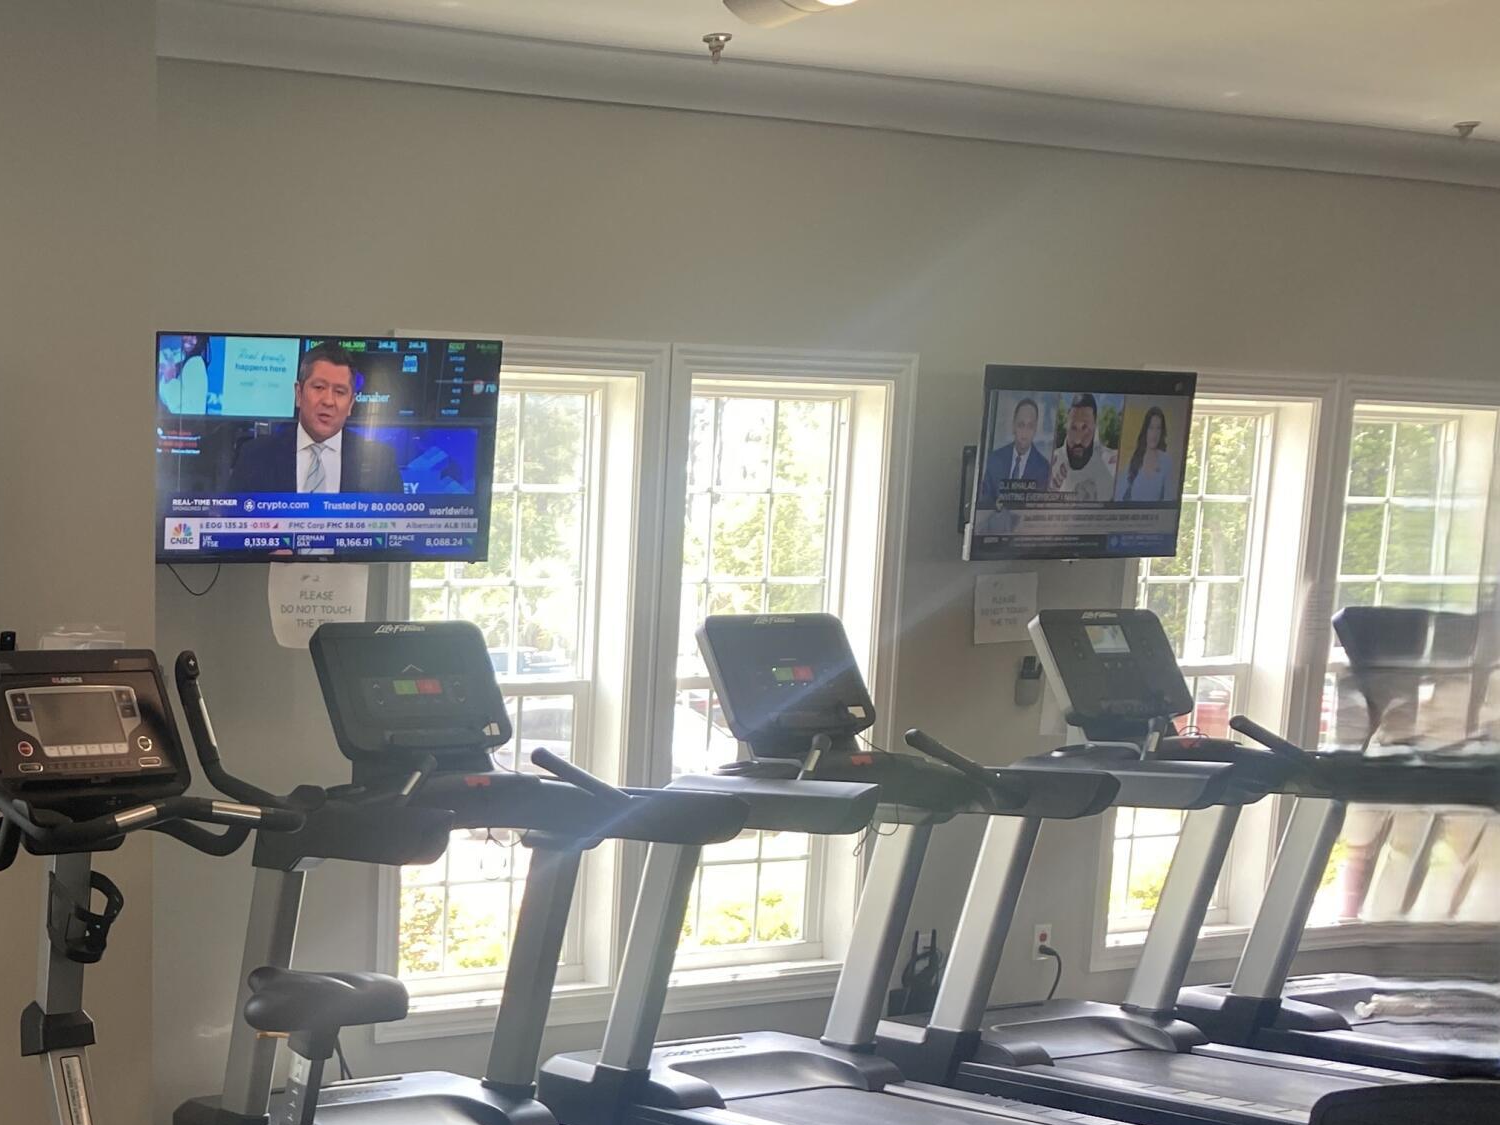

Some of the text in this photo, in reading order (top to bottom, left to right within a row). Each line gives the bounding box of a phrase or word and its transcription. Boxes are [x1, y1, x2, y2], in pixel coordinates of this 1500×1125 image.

[172, 498, 238, 506] REAL-TIME TICKER
[257, 500, 310, 511] crypto.com
[323, 501, 475, 516] Trusted by 80,000,000 worldwide
[288, 521, 305, 529] FMC
[307, 521, 325, 531] Corp
[326, 521, 343, 529] FMC
[170, 537, 194, 545] CNBC
[244, 537, 280, 547] 8,139.83
[335, 537, 373, 547] 18,166.91
[425, 537, 463, 547] 8,088.24
[300, 590, 334, 600] PLEASE
[280, 604, 351, 615] DO NOT TOUCH
[296, 618, 315, 628] THE
